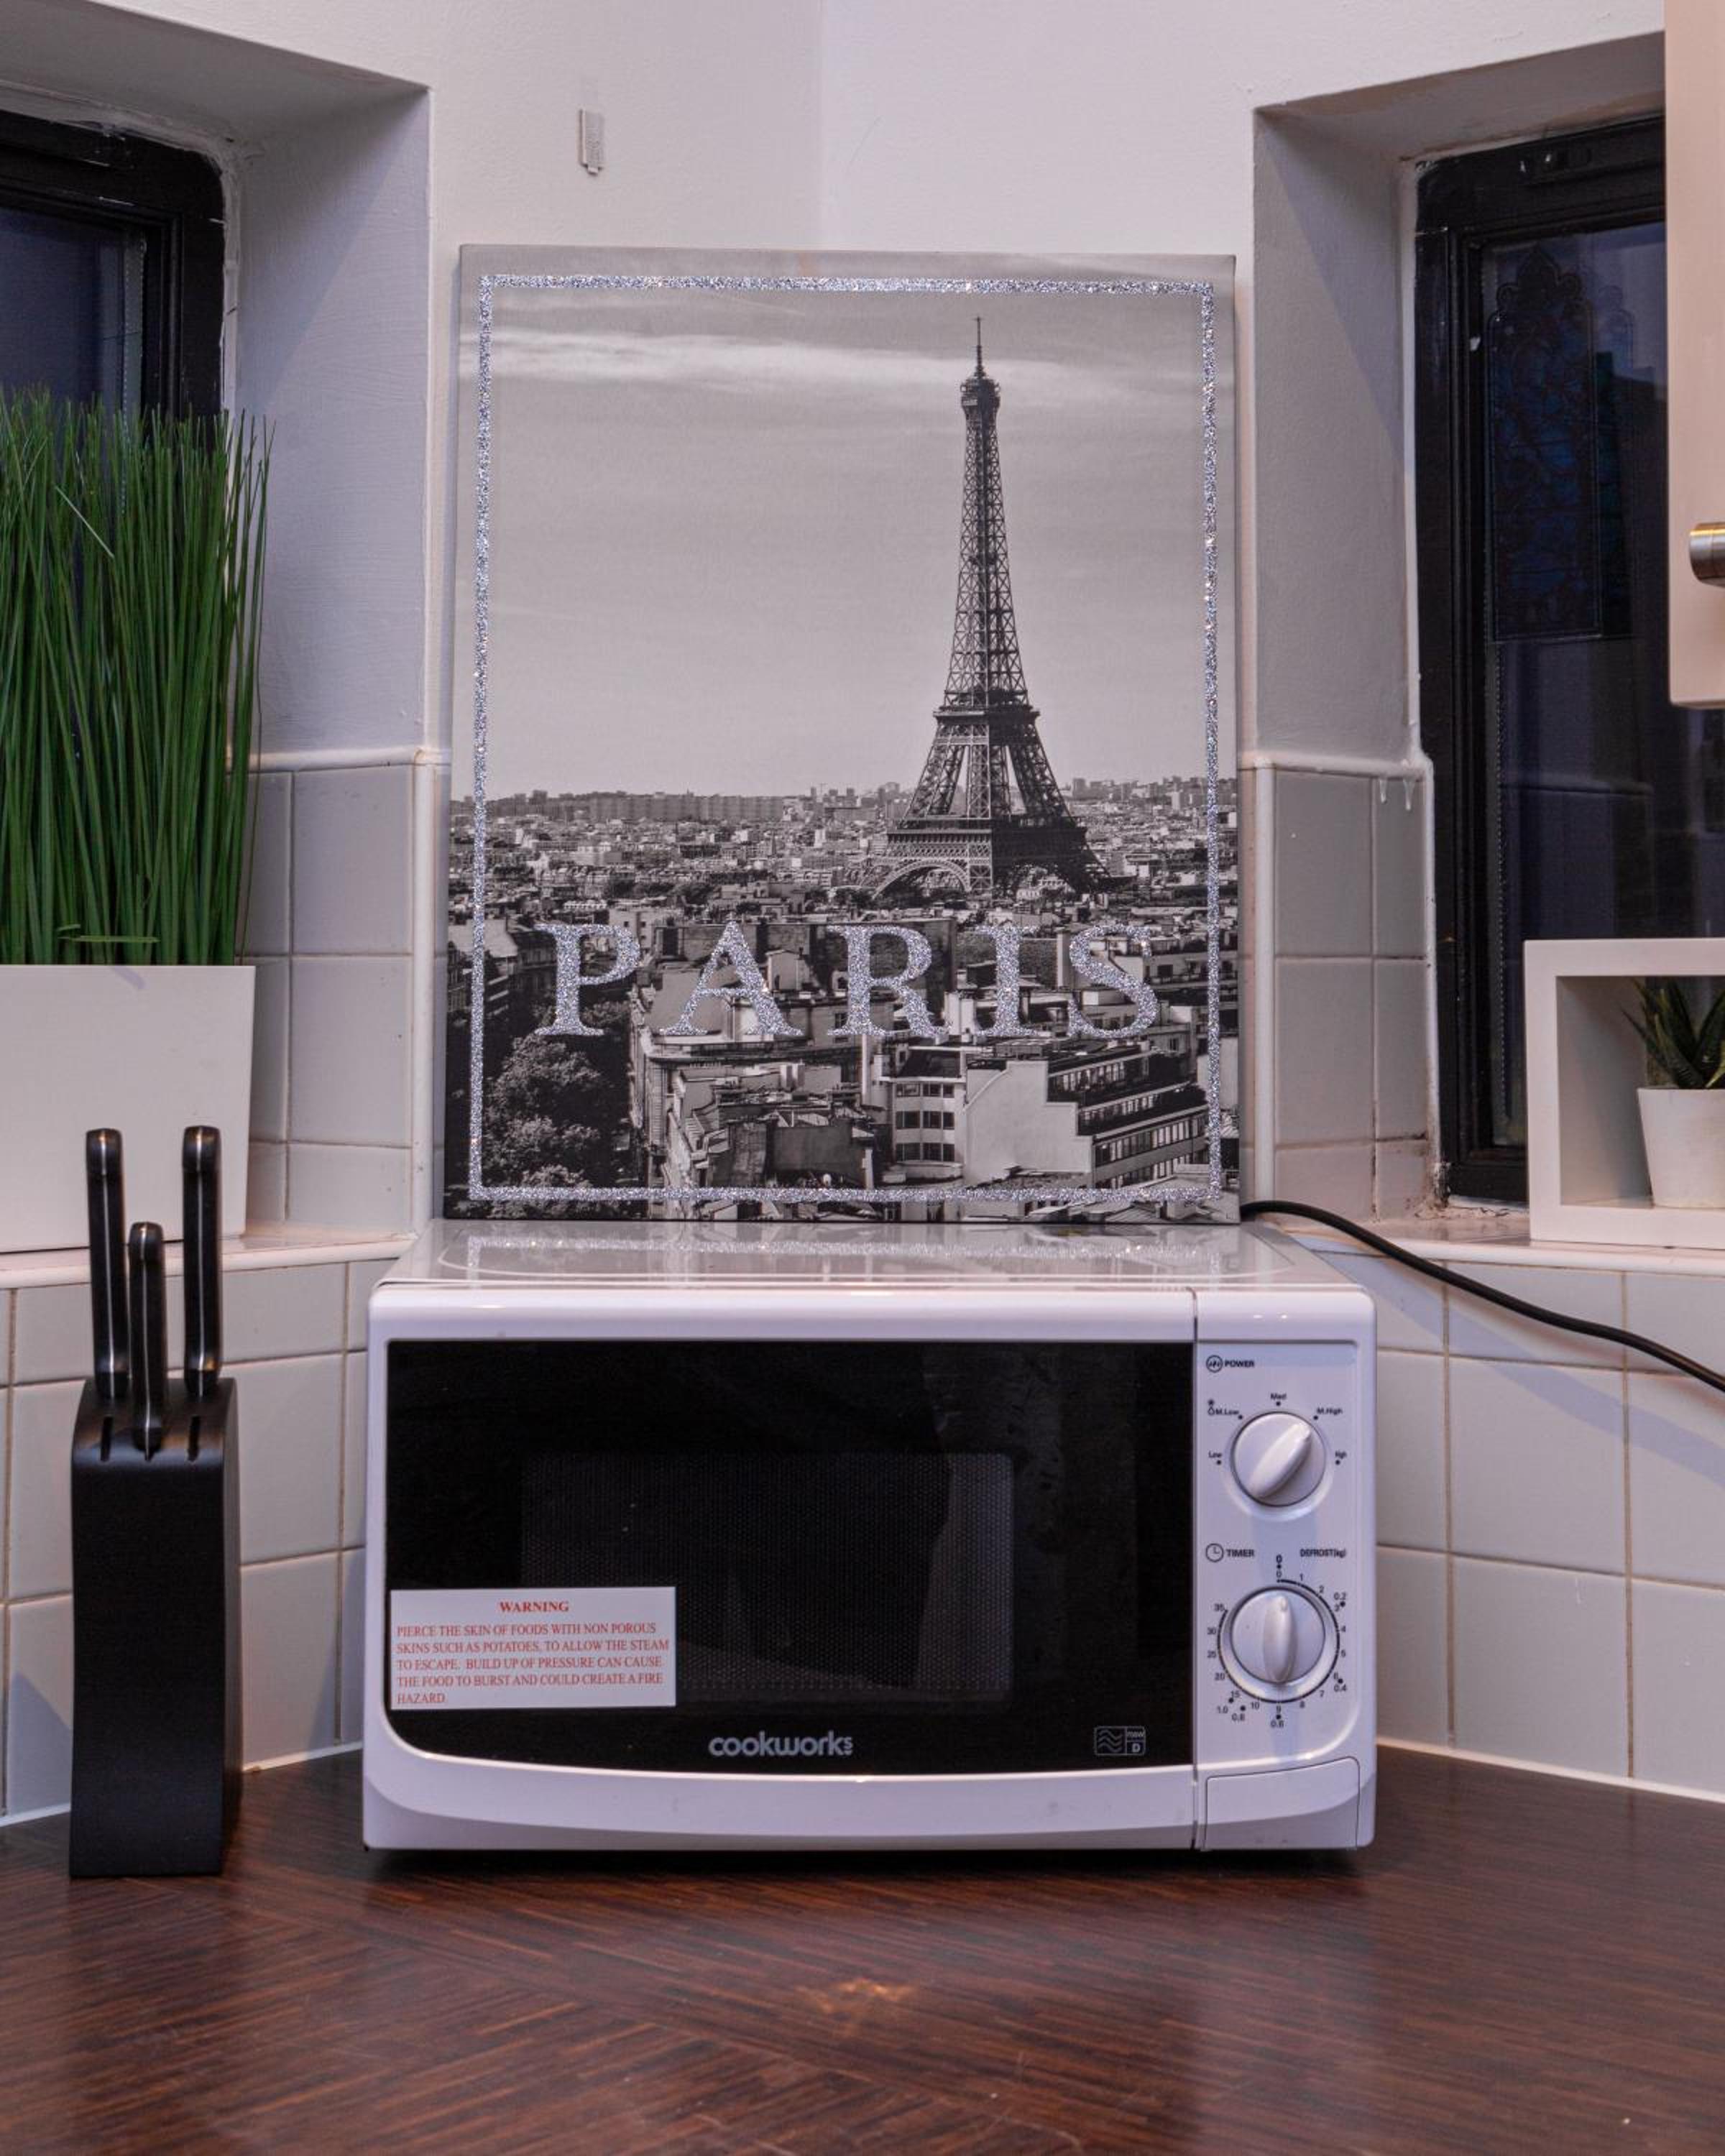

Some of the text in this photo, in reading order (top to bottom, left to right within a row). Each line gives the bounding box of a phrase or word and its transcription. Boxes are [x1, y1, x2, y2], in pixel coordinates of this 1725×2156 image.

[535, 919, 1158, 1039] PARIS
[1225, 1549, 1255, 1557] TIMER
[1276, 1554, 1282, 1563] 0
[500, 1600, 569, 1613] WARNING
[397, 1622, 656, 1636] PIERCE THE SKIN OF FOODS WITH NON POROUS
[397, 1642, 430, 1654] SKINS
[433, 1642, 464, 1653] SUCH
[467, 1641, 480, 1653] AS
[545, 1641, 560, 1651] TO
[562, 1640, 603, 1651] ALLOW
[605, 1640, 627, 1651] THE
[630, 1639, 669, 1651] STEAM
[397, 1660, 412, 1670] TO
[466, 1659, 501, 1669] BUILD
[504, 1658, 519, 1669] UP
[520, 1658, 535, 1668] OF
[538, 1657, 594, 1668] PRESSURE
[597, 1657, 622, 1667] CAN
[625, 1656, 662, 1667] CAUSE
[397, 1677, 420, 1687] THE
[422, 1676, 454, 1687] FOOD
[456, 1676, 472, 1687] TO
[474, 1675, 510, 1687] BURST
[512, 1674, 538, 1686] AND
[540, 1674, 580, 1685] COULD
[582, 1674, 627, 1685] CREATE
[638, 1673, 663, 1685] FIRE
[397, 1693, 446, 1704] HAZARD
[708, 1731, 854, 1756] cookworks
